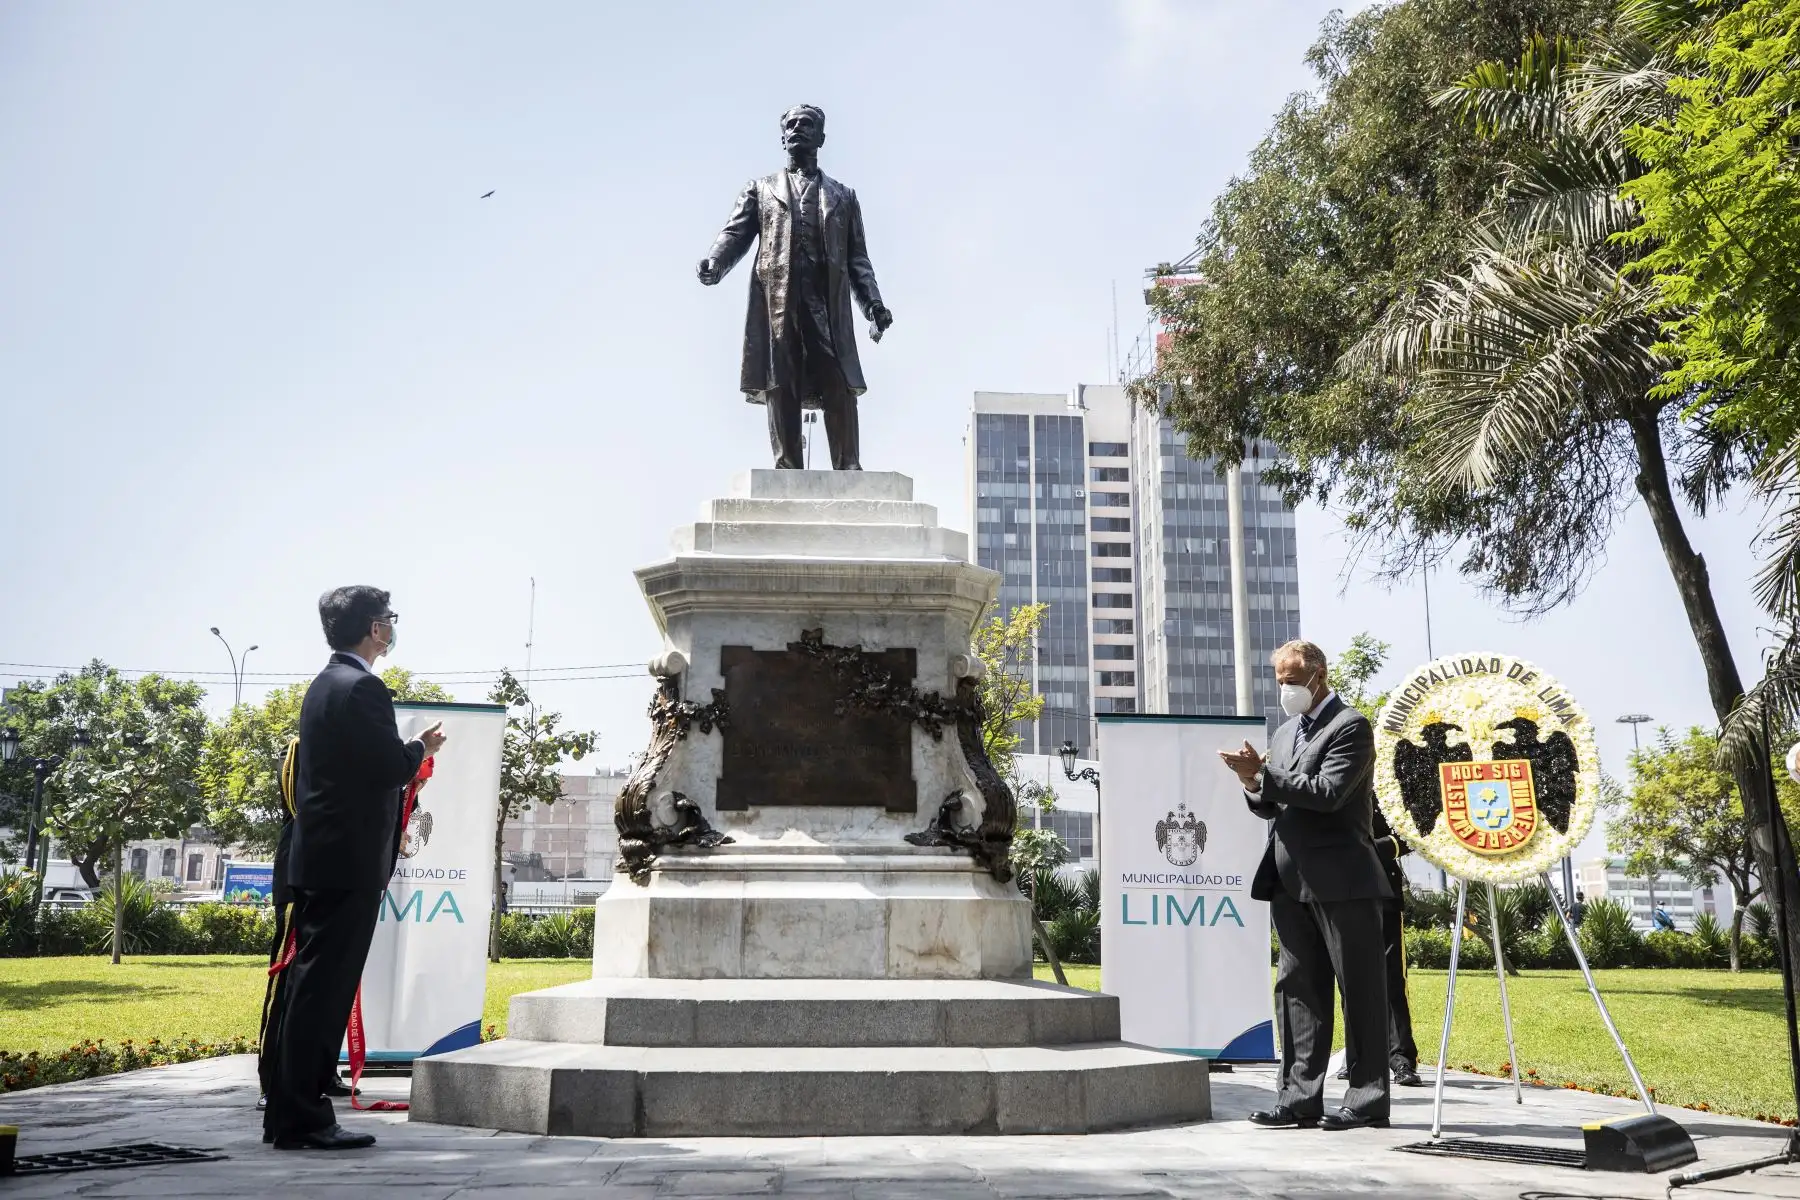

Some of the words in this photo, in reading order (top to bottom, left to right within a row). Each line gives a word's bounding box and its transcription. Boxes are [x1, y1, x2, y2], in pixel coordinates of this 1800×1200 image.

[1383, 657, 1501, 734] MUNICIPALIDAD
[1506, 662, 1537, 686] DE
[1537, 686, 1577, 725] LIMA
[1451, 764, 1483, 781] HOC
[392, 867, 445, 879] ALIDAD
[448, 869, 466, 880] DE
[1122, 873, 1222, 885] MUNICIPALIDAD
[1225, 875, 1242, 885] DE
[379, 889, 464, 923] MA
[1122, 893, 1245, 928] LIMA
